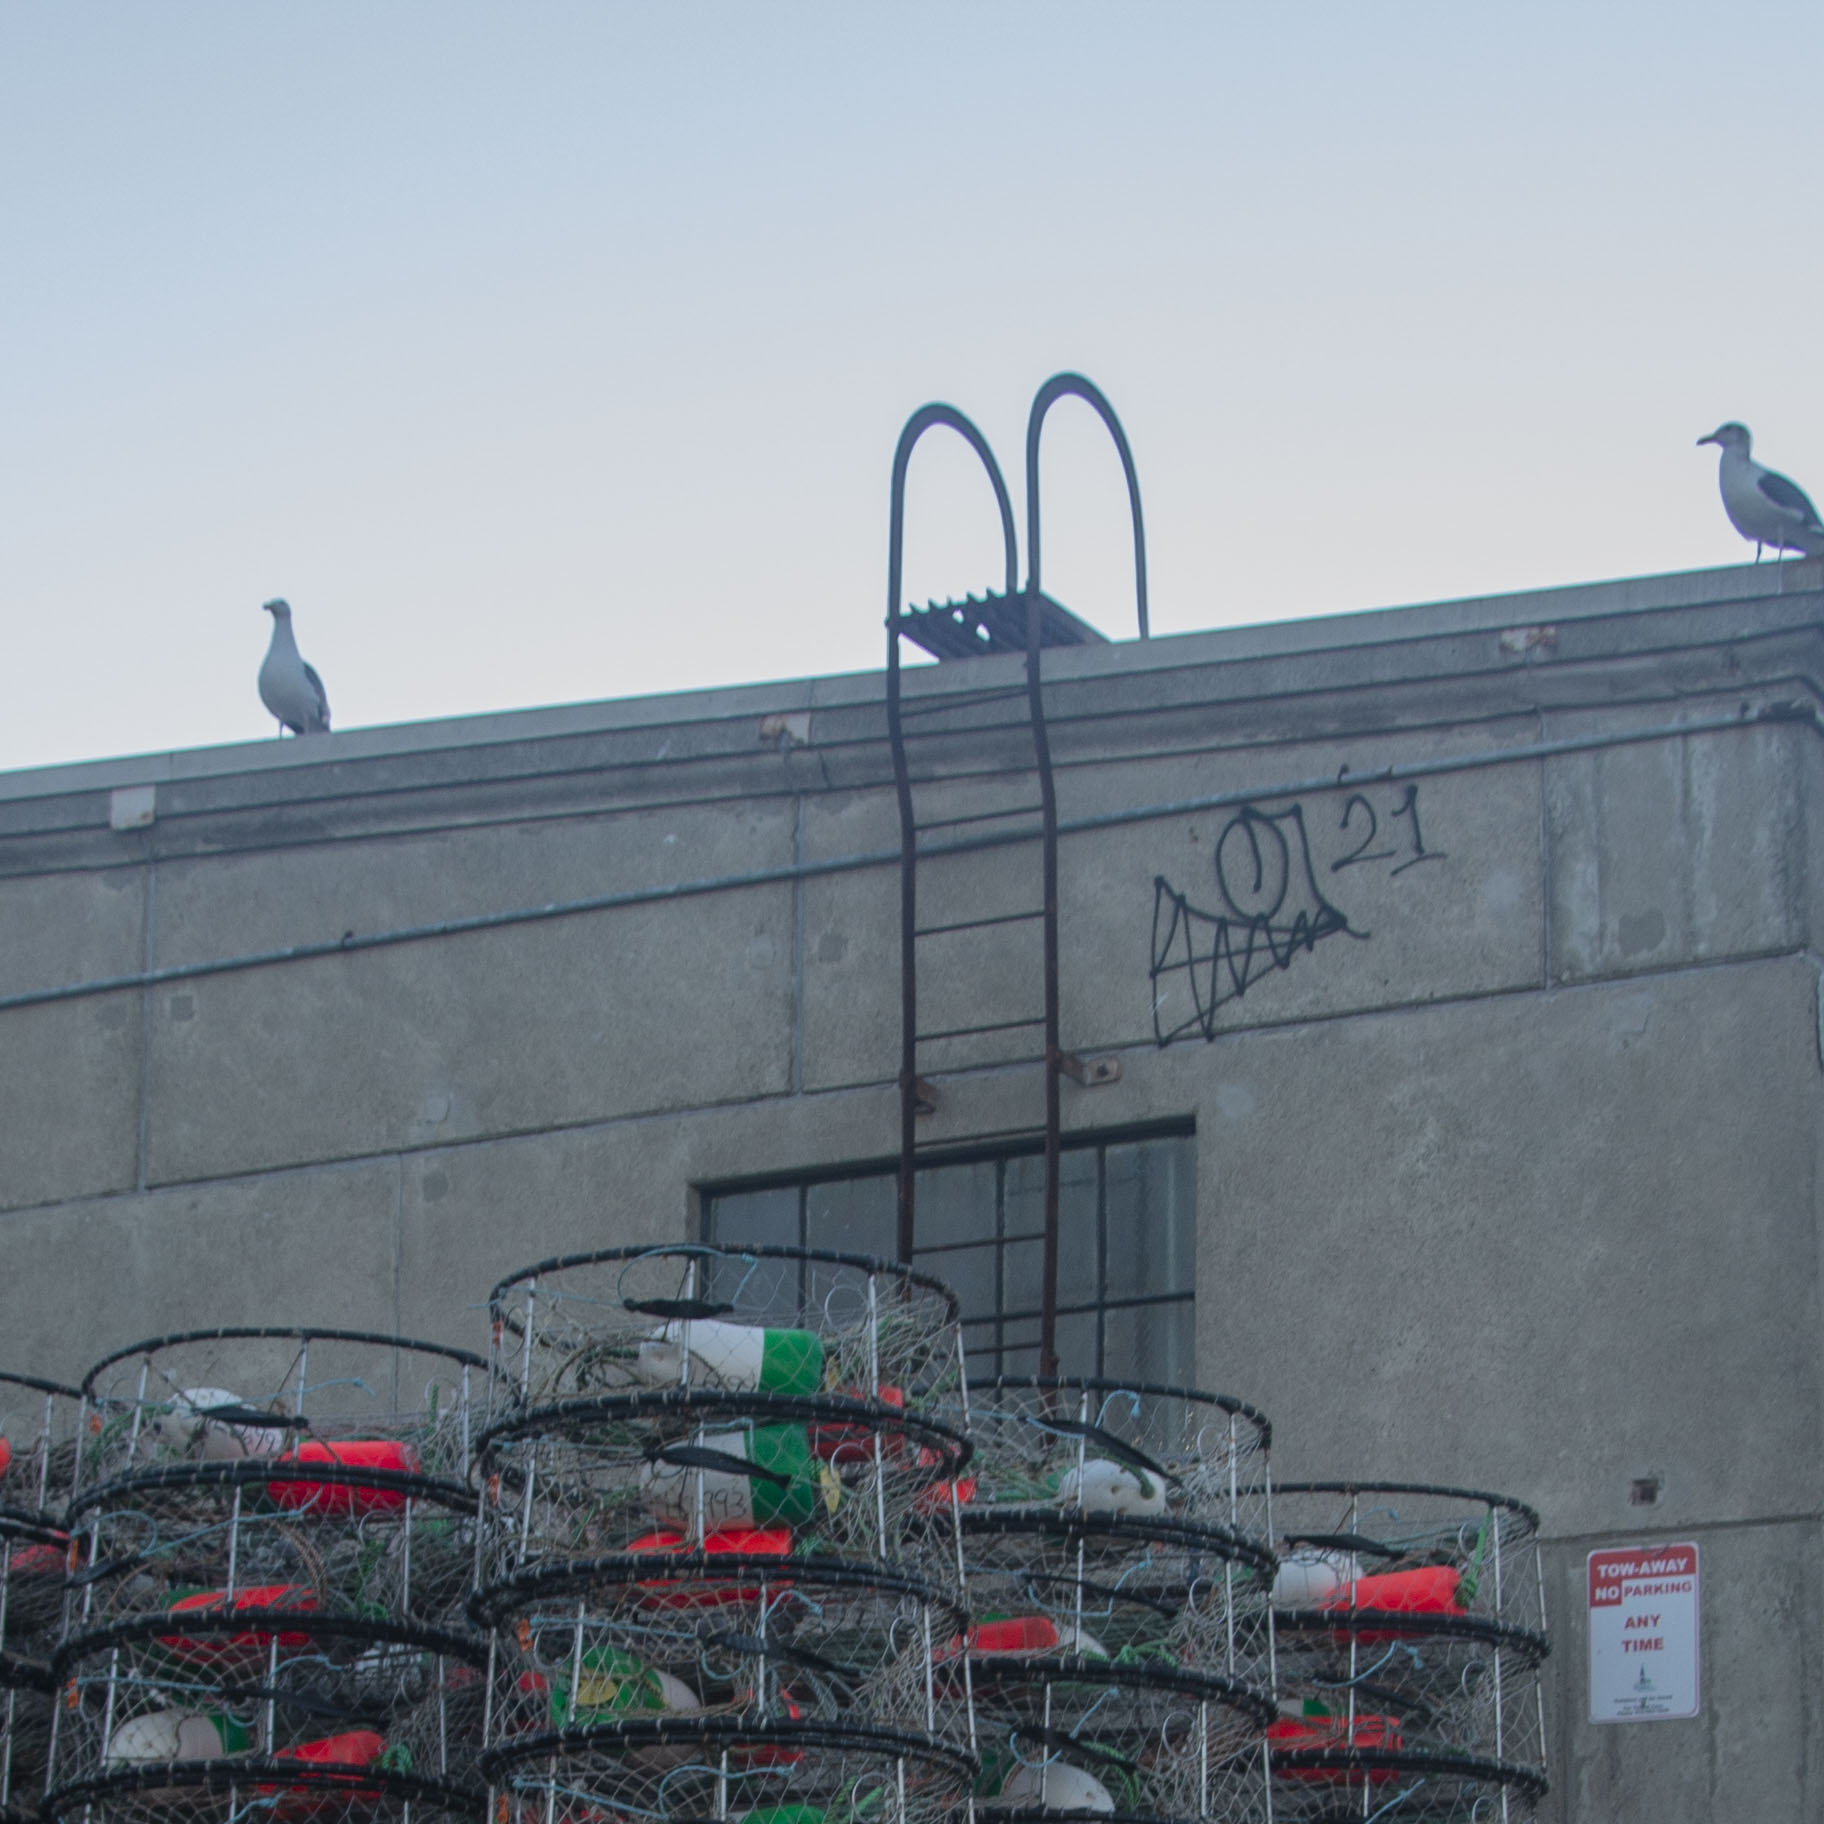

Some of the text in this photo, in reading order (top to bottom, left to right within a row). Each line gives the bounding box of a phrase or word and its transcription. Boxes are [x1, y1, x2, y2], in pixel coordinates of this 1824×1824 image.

[1597, 1557, 1688, 1579] TOW-AWAY
[1595, 1580, 1692, 1601] NO PARKING
[1624, 1613, 1662, 1630] ANY
[1621, 1636, 1664, 1653] TIME
